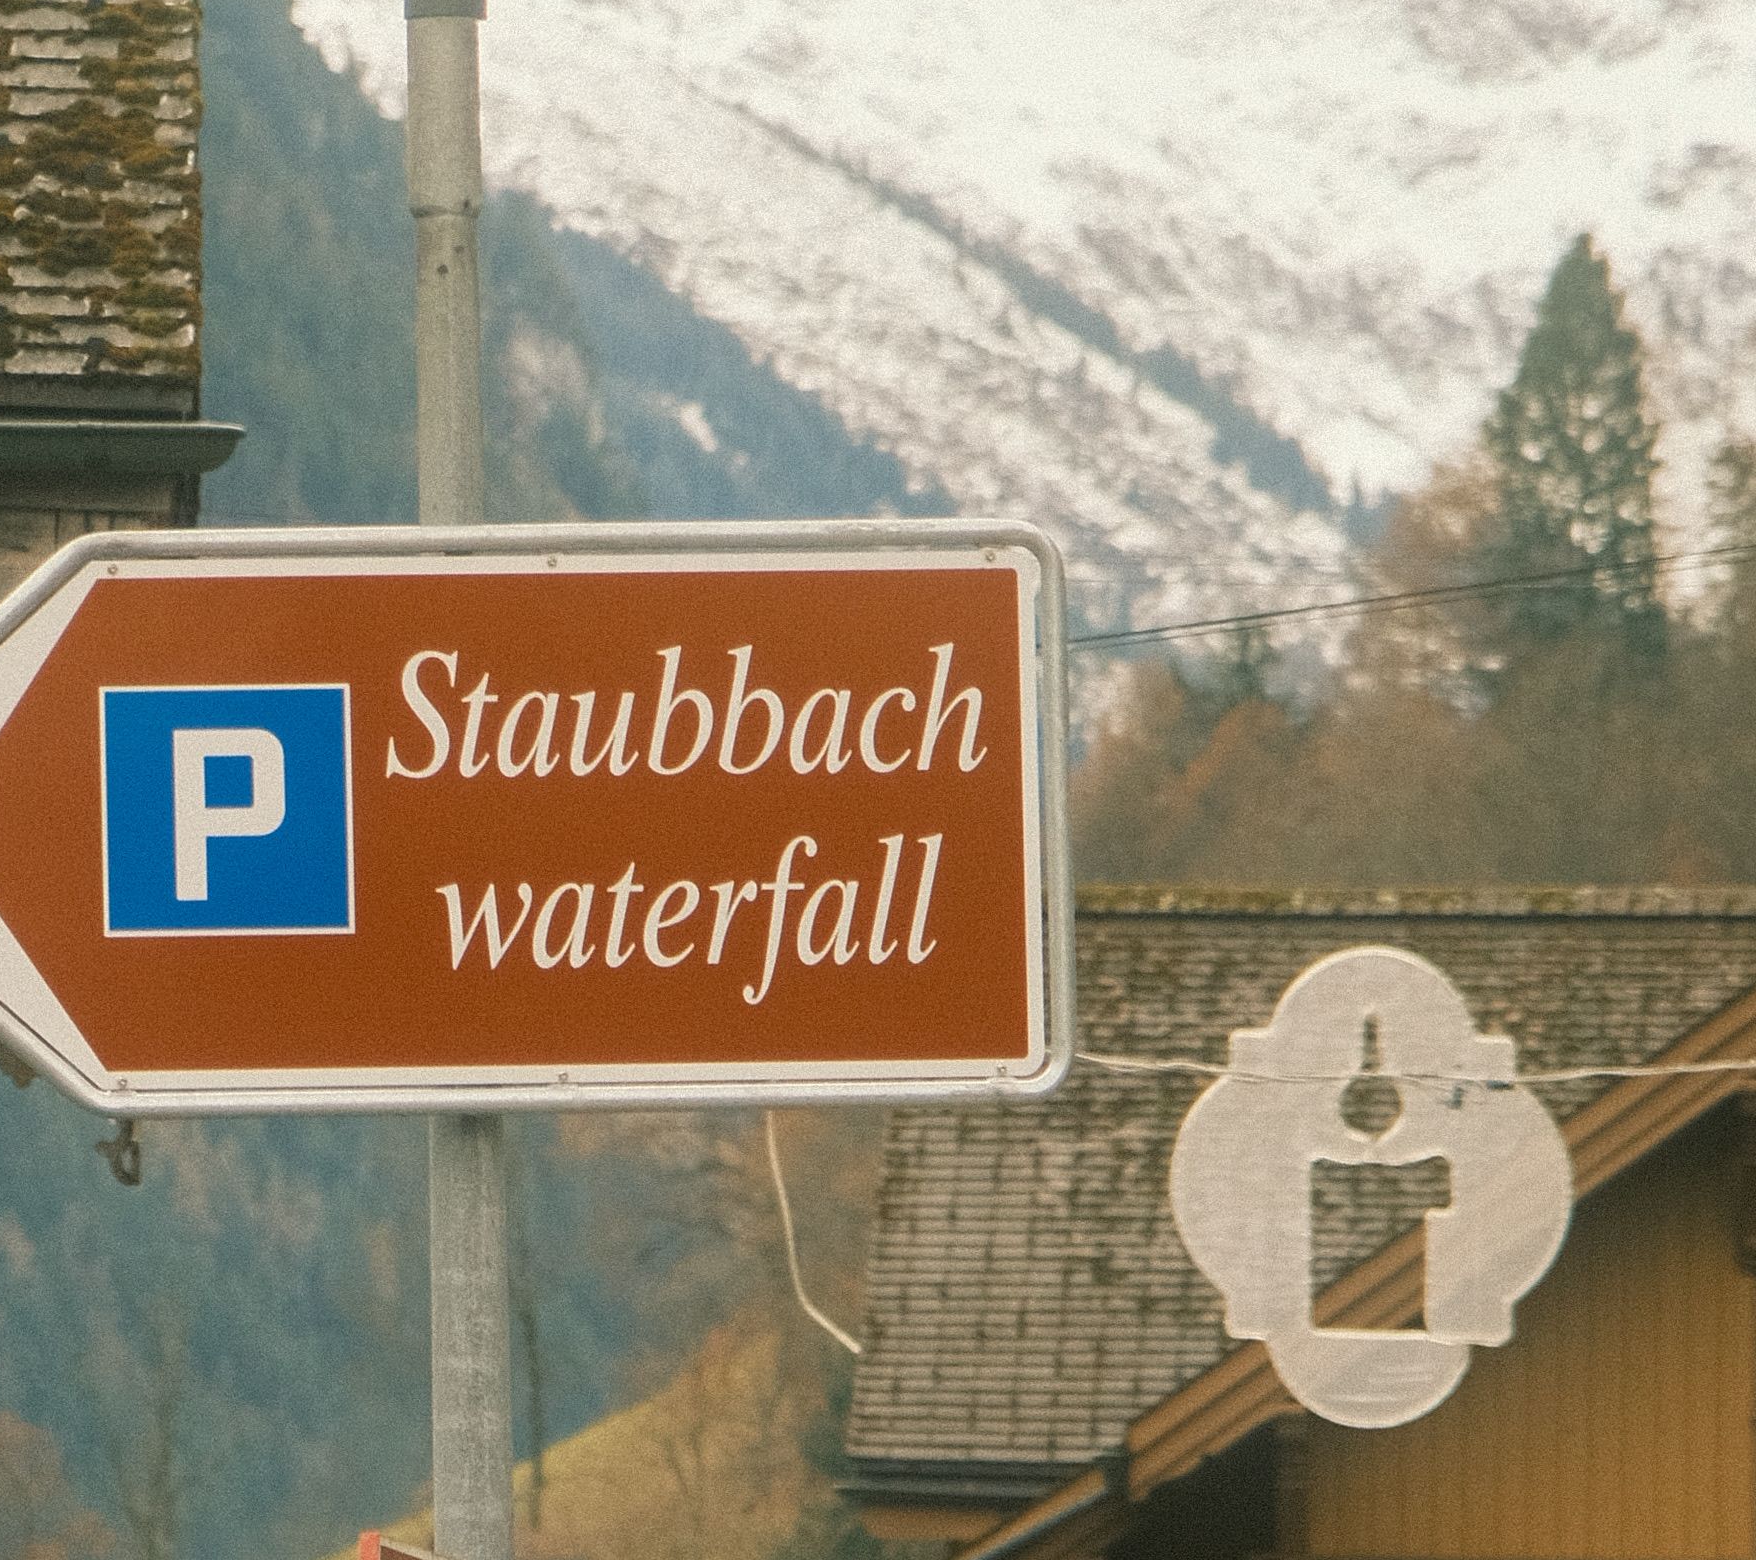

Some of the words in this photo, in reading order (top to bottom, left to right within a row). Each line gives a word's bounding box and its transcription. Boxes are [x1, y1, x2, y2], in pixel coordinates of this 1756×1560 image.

[385, 641, 988, 780] Staubbach
[172, 727, 286, 902] P
[436, 832, 943, 1006] waterfall
